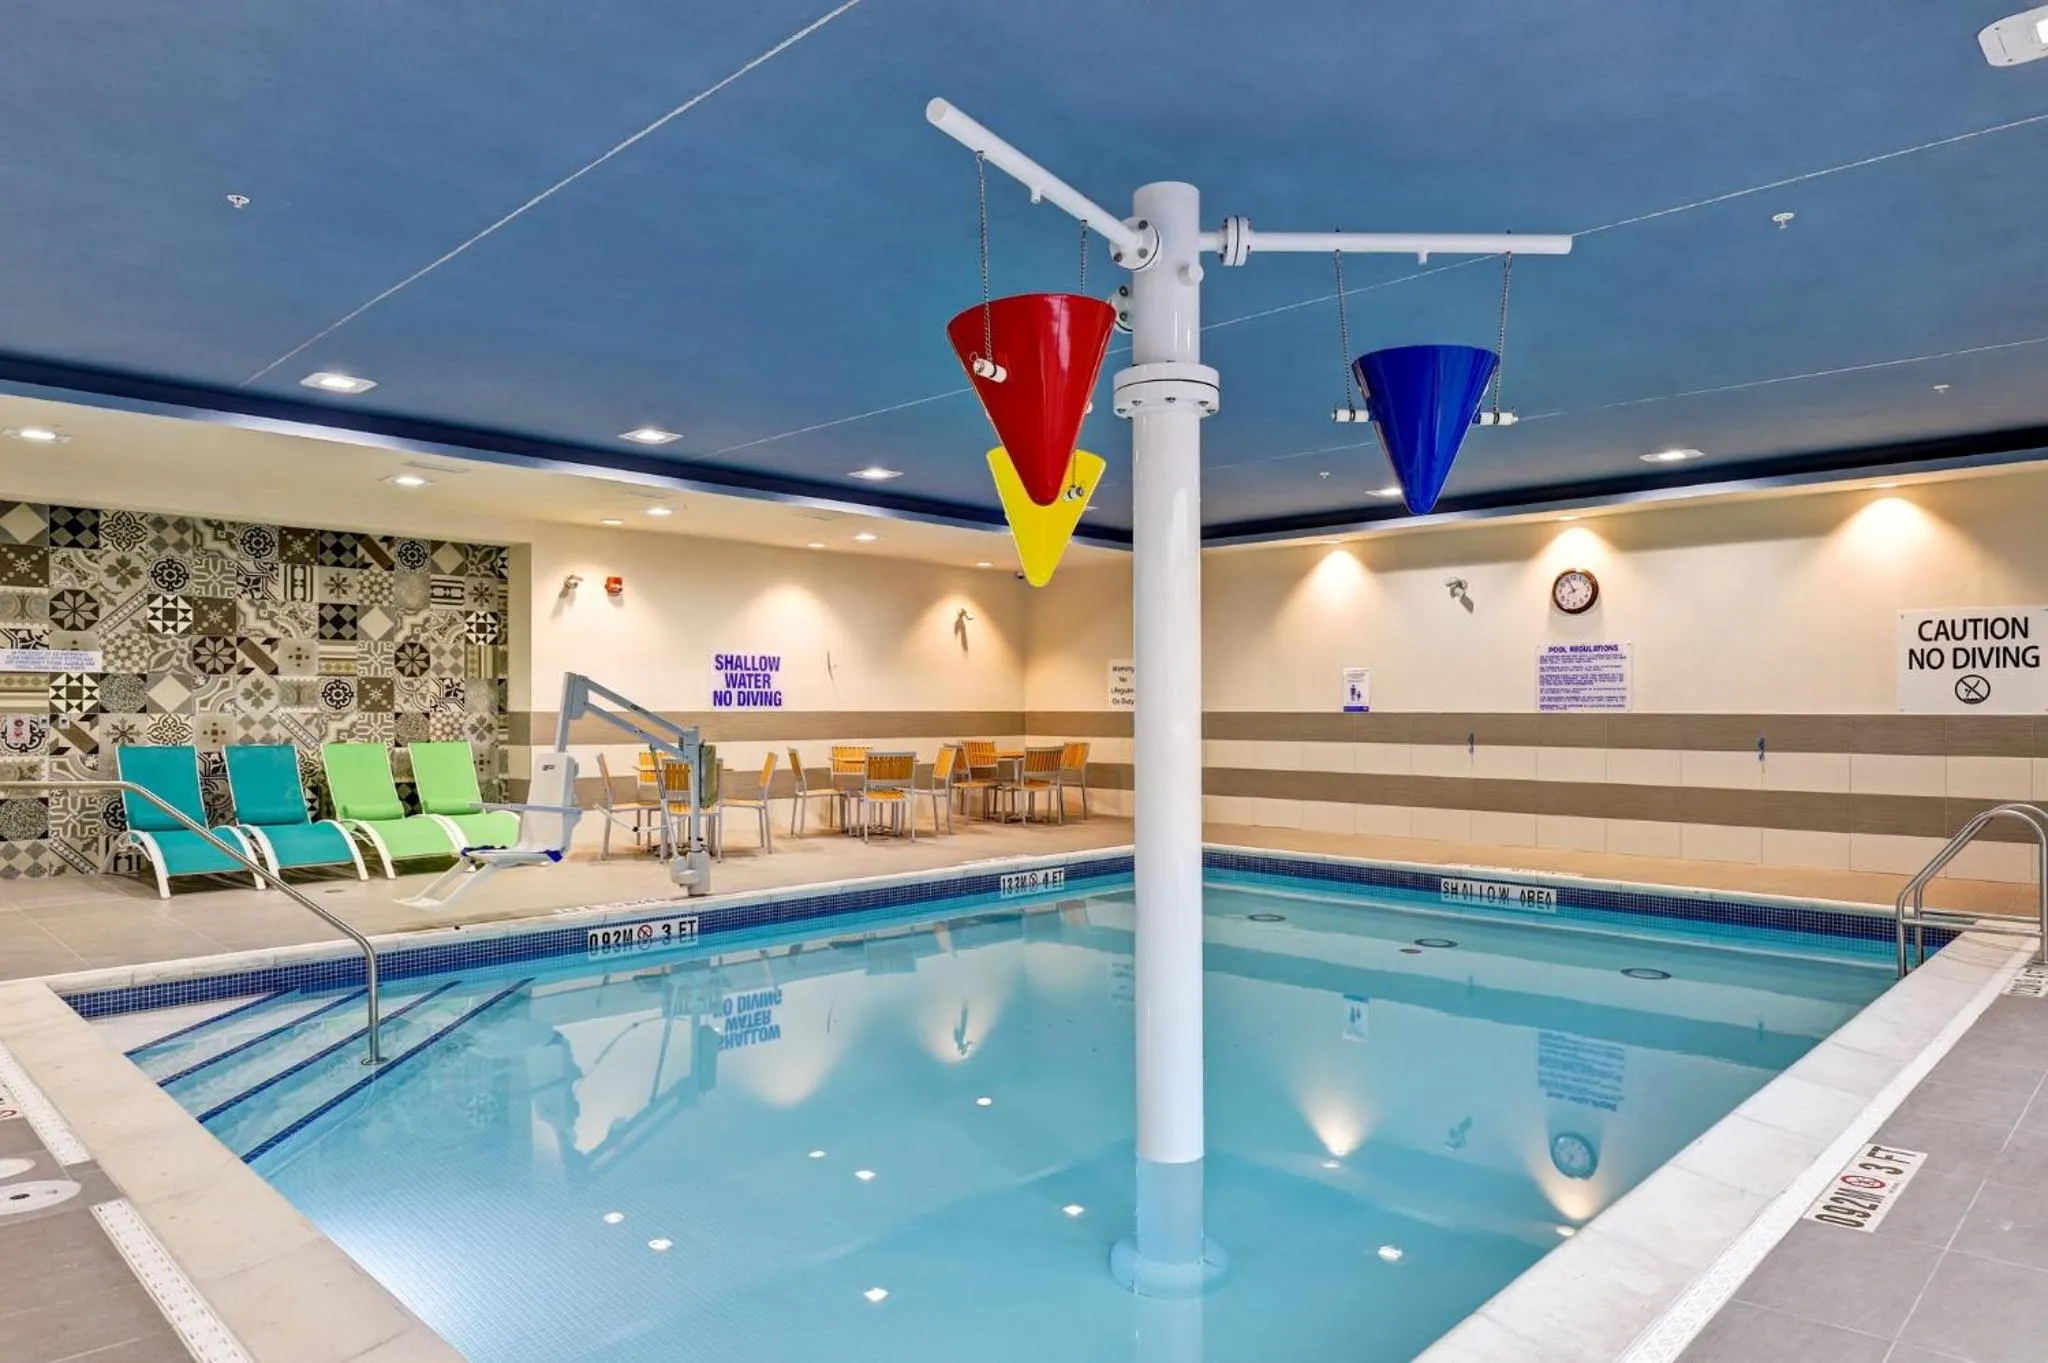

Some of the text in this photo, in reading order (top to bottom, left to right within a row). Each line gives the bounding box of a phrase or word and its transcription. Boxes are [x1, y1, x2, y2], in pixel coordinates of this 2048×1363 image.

[1918, 616, 2029, 642] CAUTION
[1570, 644, 1619, 653] REGULATIONS
[715, 654, 781, 671] SHALLOW
[1908, 645, 2040, 670] NO DIVING
[725, 673, 771, 689] WATER
[713, 690, 782, 707] NO DIVING
[1443, 881, 1552, 907] SHALLOW AREA
[1866, 1145, 1917, 1165] FT
[1858, 1163, 1904, 1176] 3
